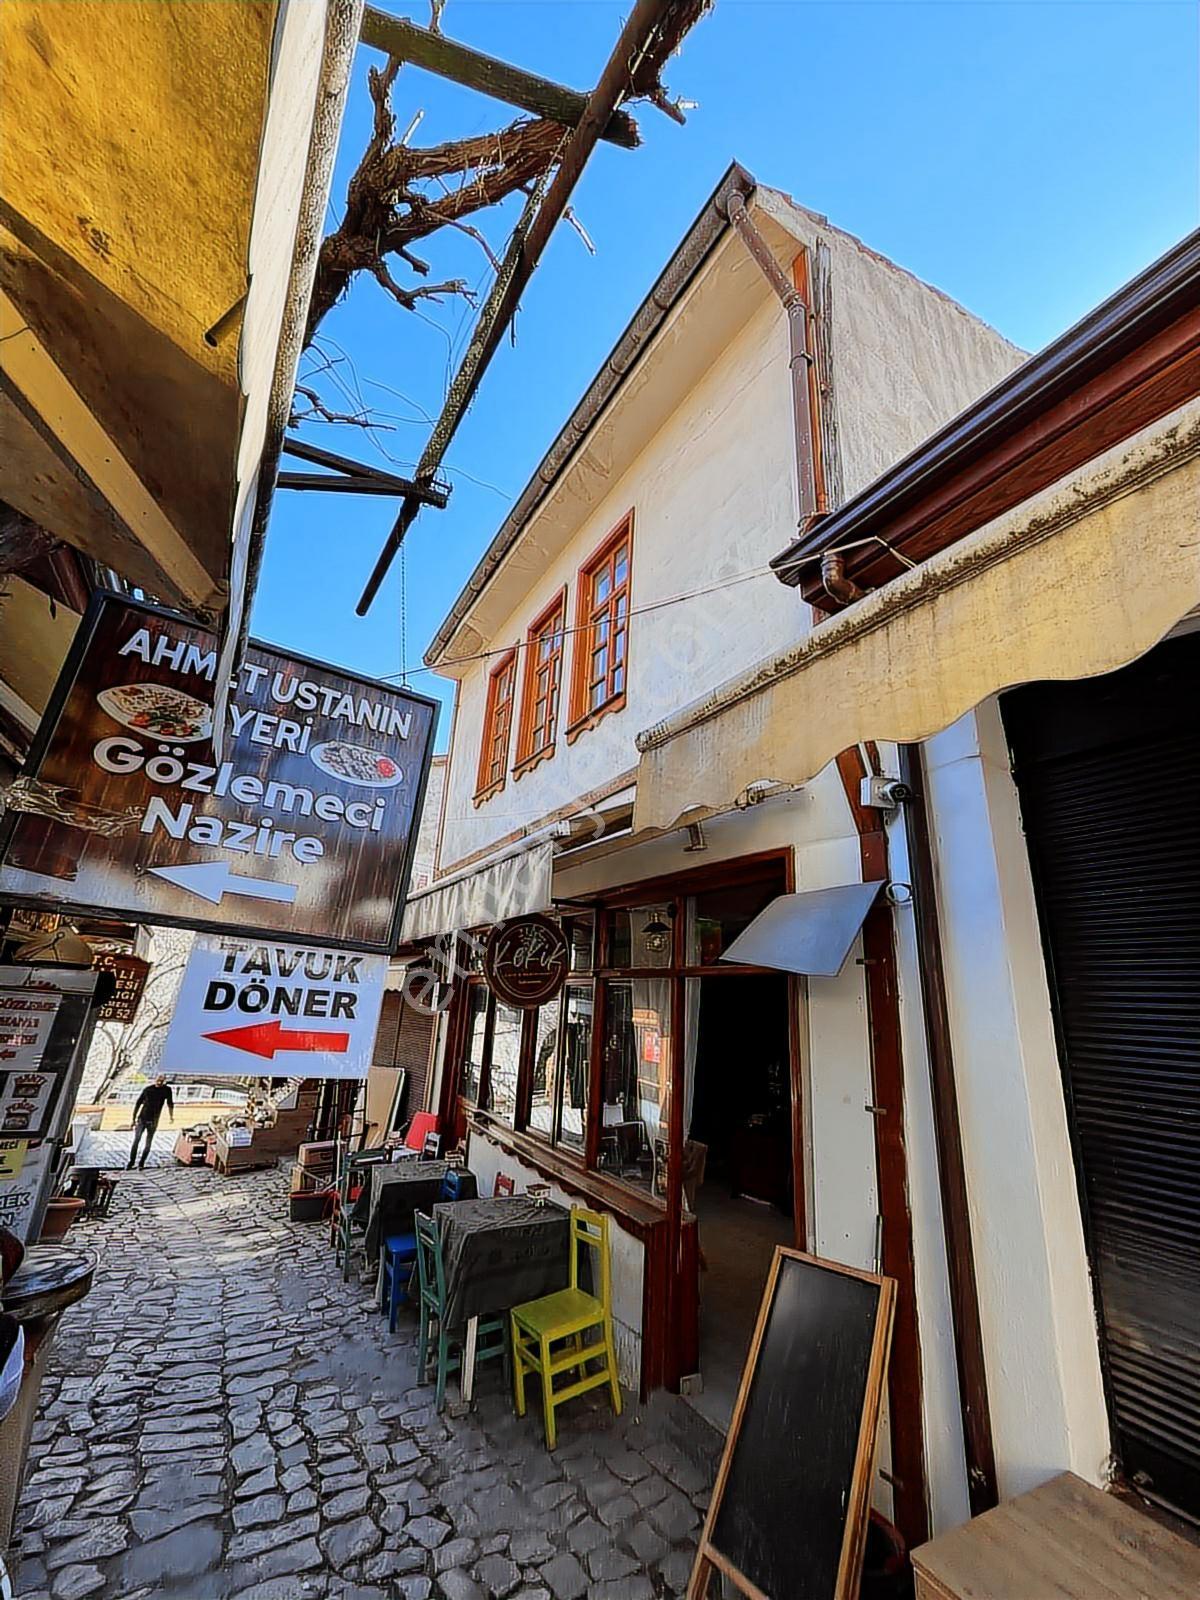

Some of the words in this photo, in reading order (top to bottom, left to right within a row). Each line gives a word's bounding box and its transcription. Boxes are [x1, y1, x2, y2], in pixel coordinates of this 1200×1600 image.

[119, 628, 268, 693] AHMT
[271, 671, 412, 739] USTANIN
[229, 704, 312, 754] YERİ
[93, 736, 387, 831] Gözlemeci
[139, 796, 324, 864] Nazire
[220, 942, 363, 983] TAVUK
[202, 978, 358, 1019] DÖNER
